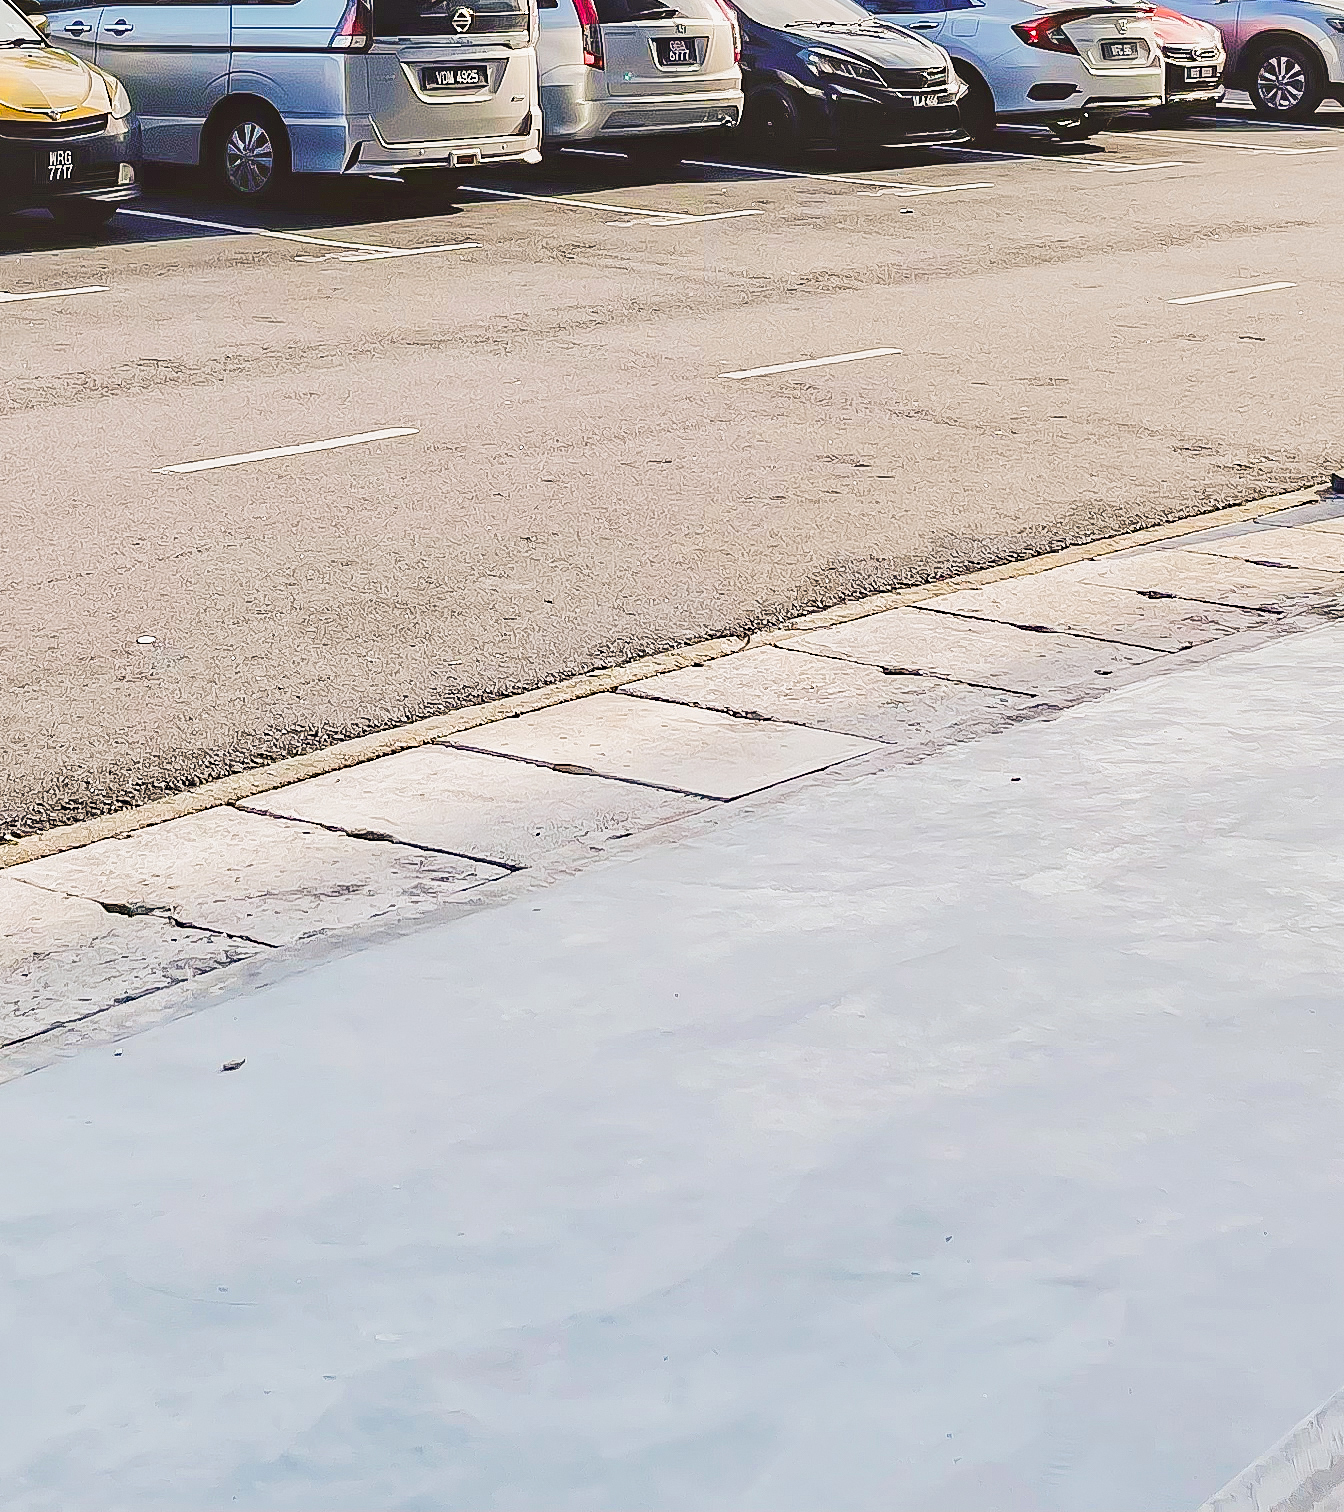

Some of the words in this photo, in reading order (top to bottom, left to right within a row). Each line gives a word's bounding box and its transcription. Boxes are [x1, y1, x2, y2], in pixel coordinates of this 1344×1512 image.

[456, 70, 479, 84] 4925
[49, 151, 72, 166] WRG
[48, 164, 73, 181] 7717
